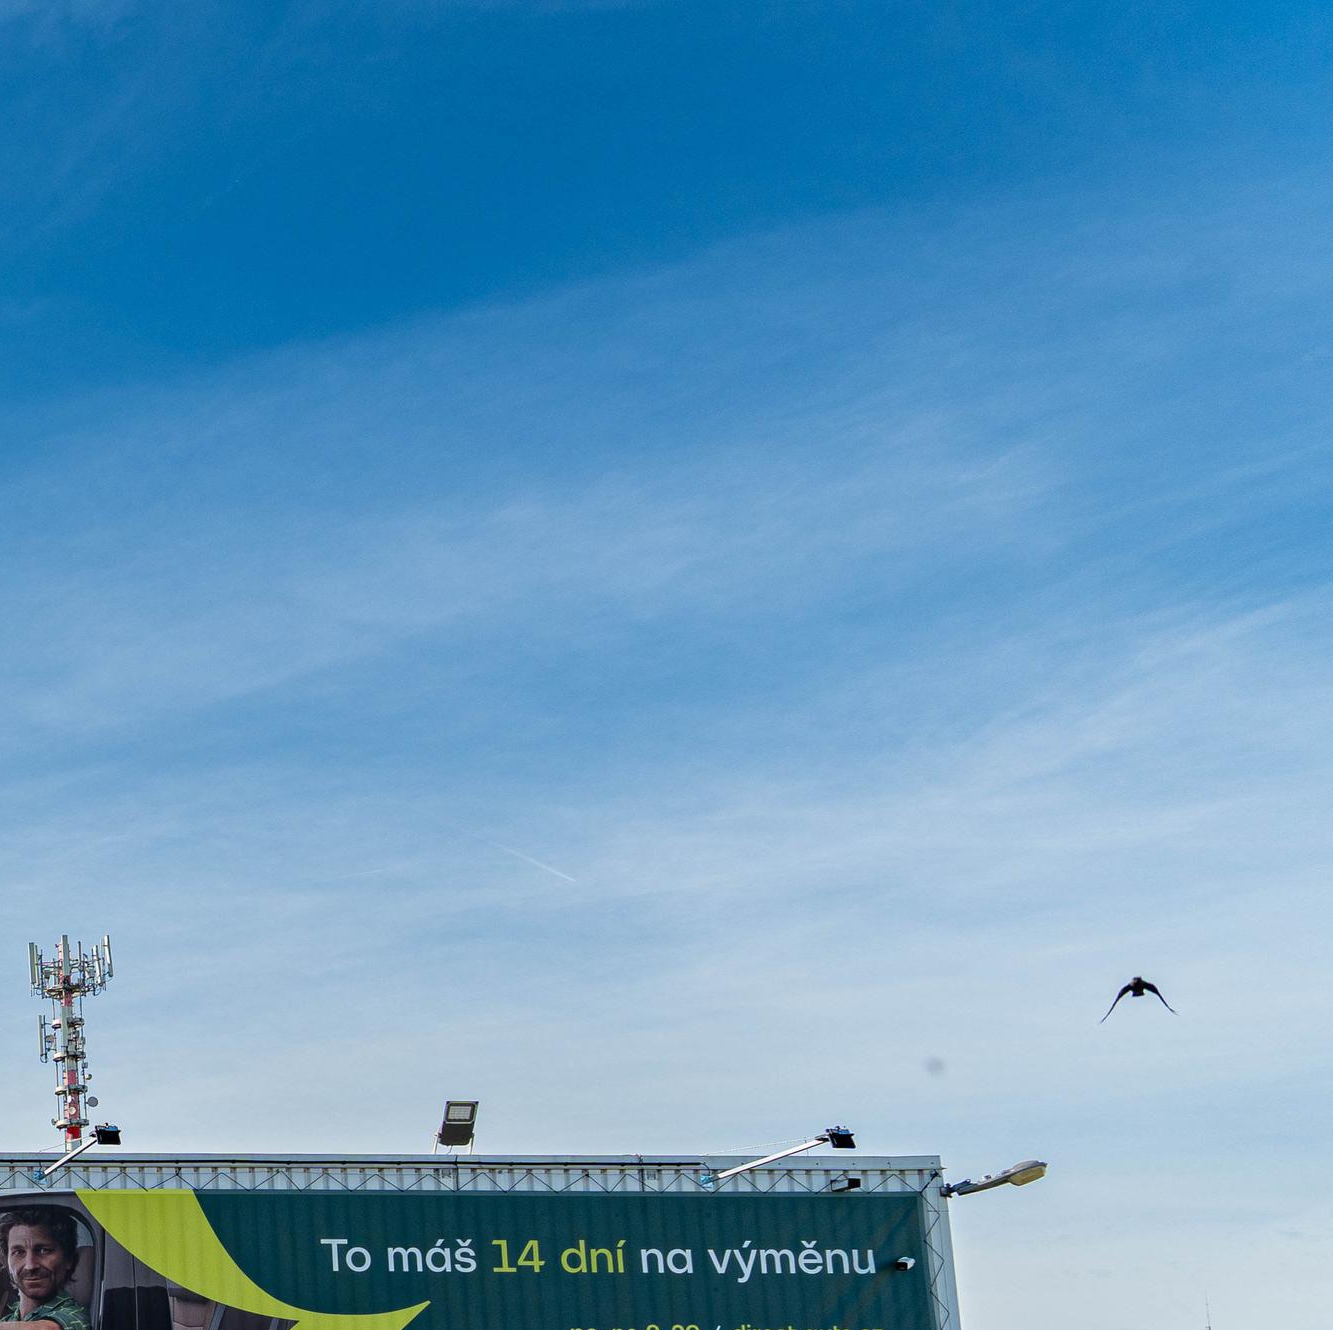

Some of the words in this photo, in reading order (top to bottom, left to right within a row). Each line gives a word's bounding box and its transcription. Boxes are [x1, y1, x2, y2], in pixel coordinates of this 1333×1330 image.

[319, 1238, 372, 1273] To
[387, 1238, 477, 1273] máš
[491, 1239, 546, 1273] 14
[560, 1239, 627, 1274] dní
[640, 1248, 694, 1275] na
[707, 1239, 877, 1284] výměnu
